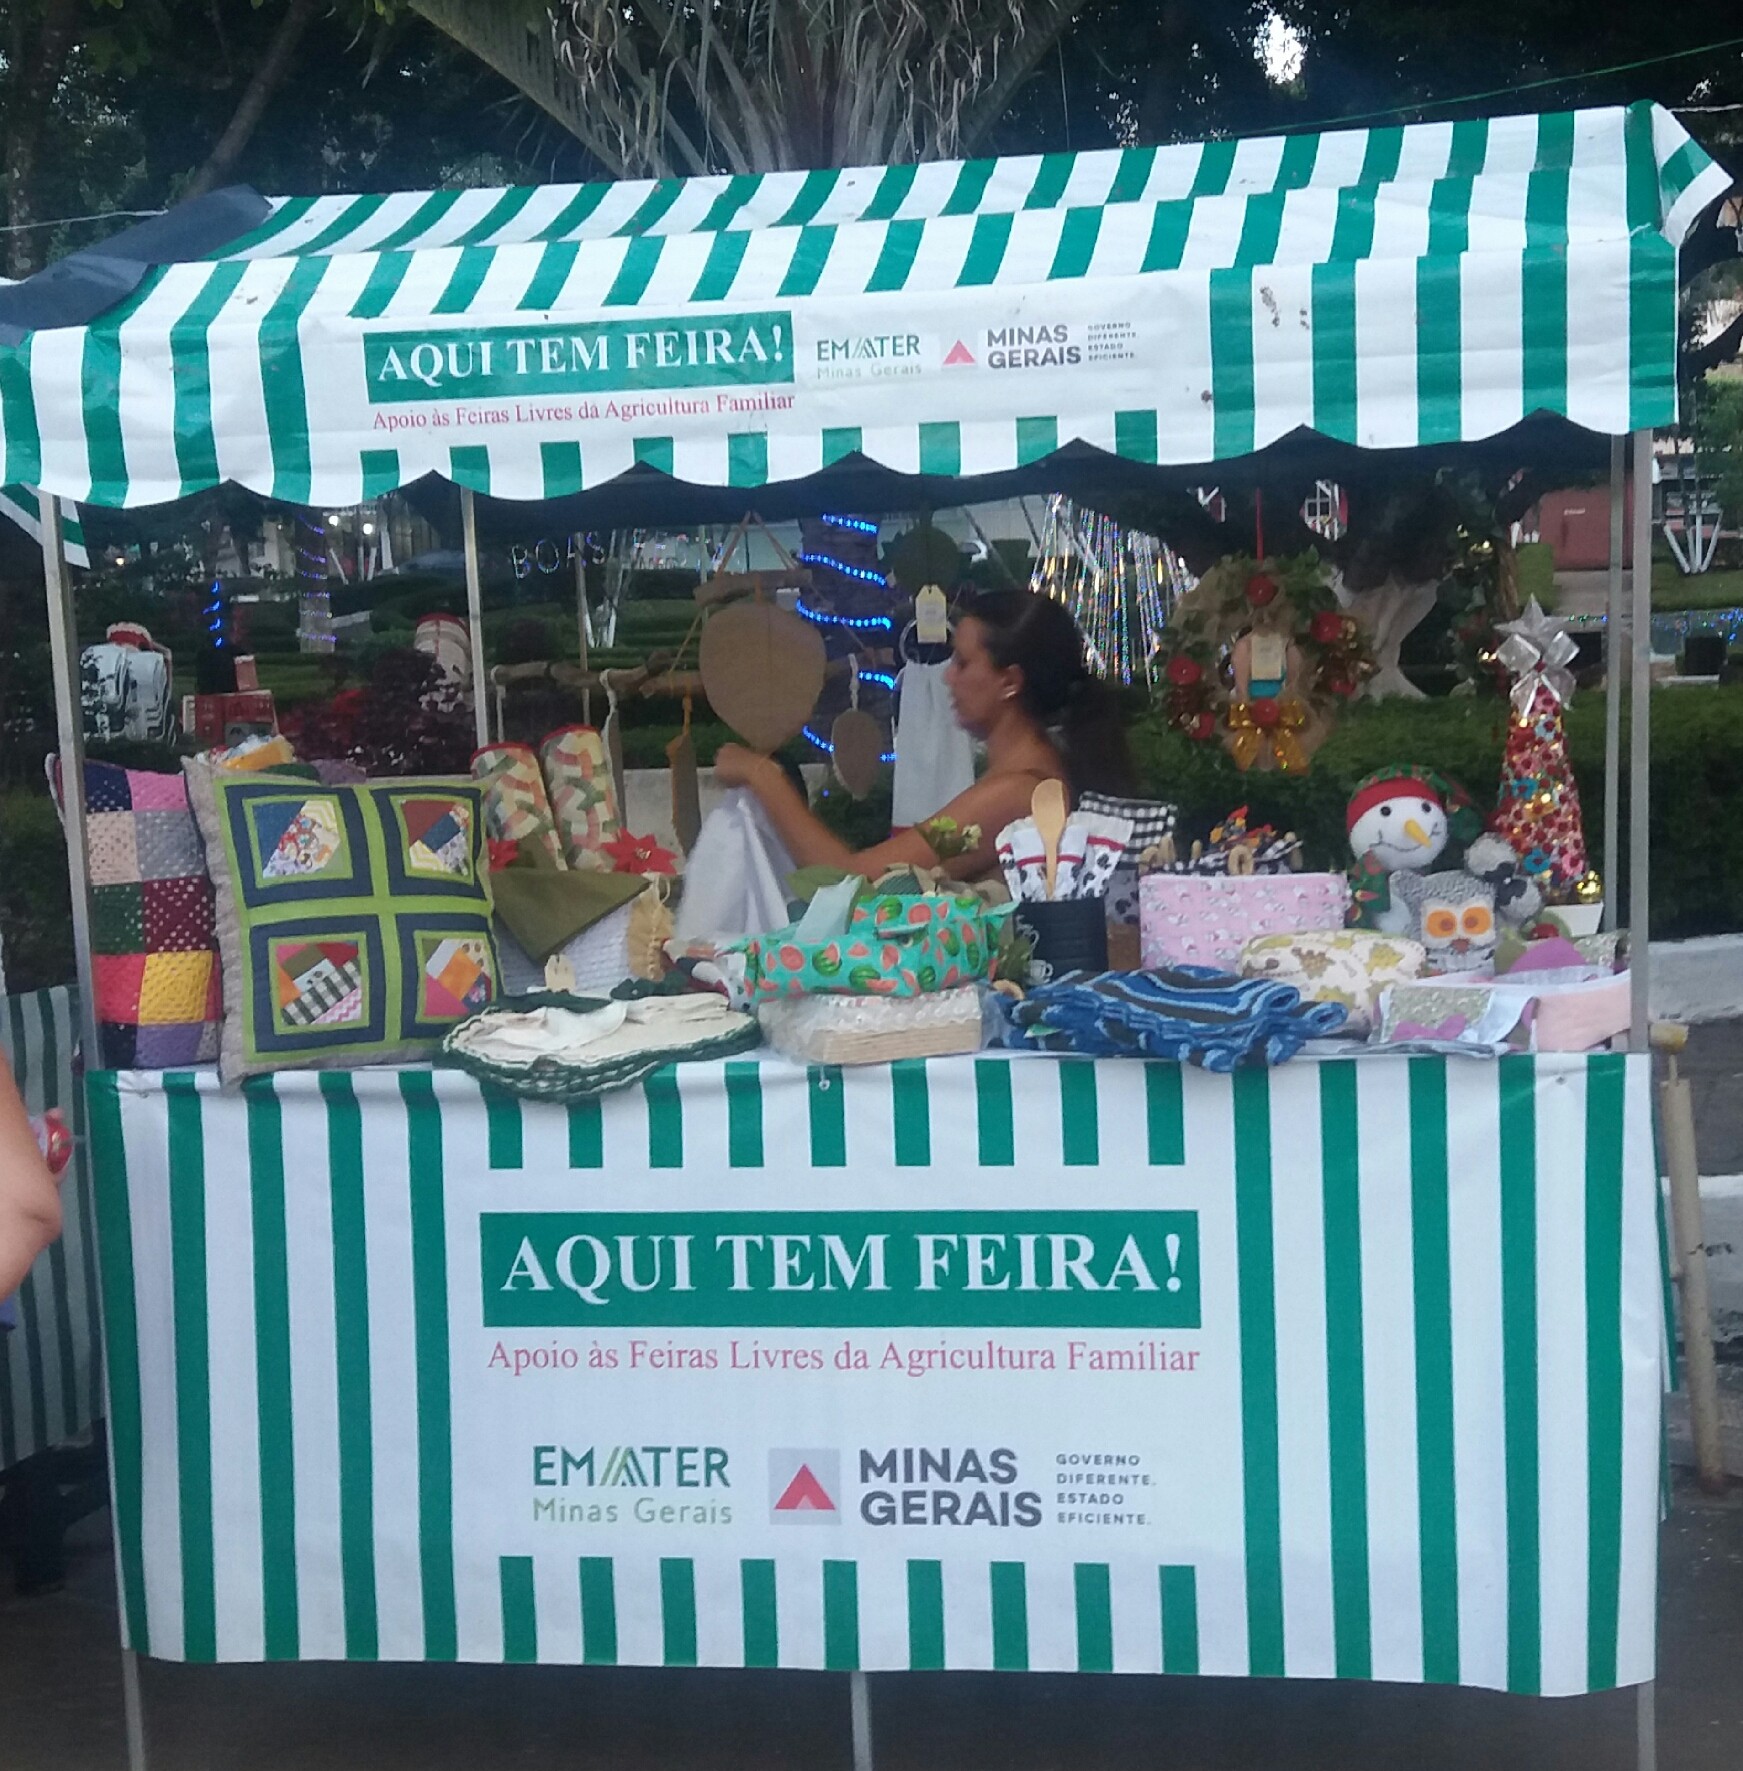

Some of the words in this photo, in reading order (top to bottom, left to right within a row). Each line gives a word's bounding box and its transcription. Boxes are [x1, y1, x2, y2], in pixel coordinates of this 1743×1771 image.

[987, 324, 1069, 347] MINAS
[378, 341, 496, 388] AQUI
[506, 334, 610, 375] TEM
[625, 325, 784, 370] FEIRA!
[817, 366, 862, 380] Minas
[871, 362, 922, 377] Gerais
[987, 346, 1082, 369] GERAIS
[373, 409, 427, 432] Apoio
[432, 408, 450, 426] às
[456, 406, 509, 425] Feiras
[515, 403, 573, 422] Livres
[578, 401, 600, 420] da
[605, 397, 710, 422] Agricultura
[716, 392, 795, 412] Familiar
[500, 1234, 697, 1305] AQUI
[716, 1234, 892, 1292] TEM
[913, 1233, 1182, 1293] FEIRA!
[488, 1340, 578, 1377] Apoio
[588, 1340, 619, 1370] às
[629, 1340, 719, 1370] Feiras
[730, 1340, 824, 1371] Livres
[834, 1340, 871, 1371] da
[880, 1340, 1056, 1378] Agricultura
[1067, 1341, 1201, 1372] Familiar
[860, 1448, 1018, 1485] MINAS
[1056, 1453, 1141, 1466] GOVERNO
[533, 1497, 619, 1524] Minas
[634, 1497, 733, 1525] Gerais
[860, 1490, 1043, 1527] GERAIS
[1057, 1492, 1124, 1505] ESTADO
